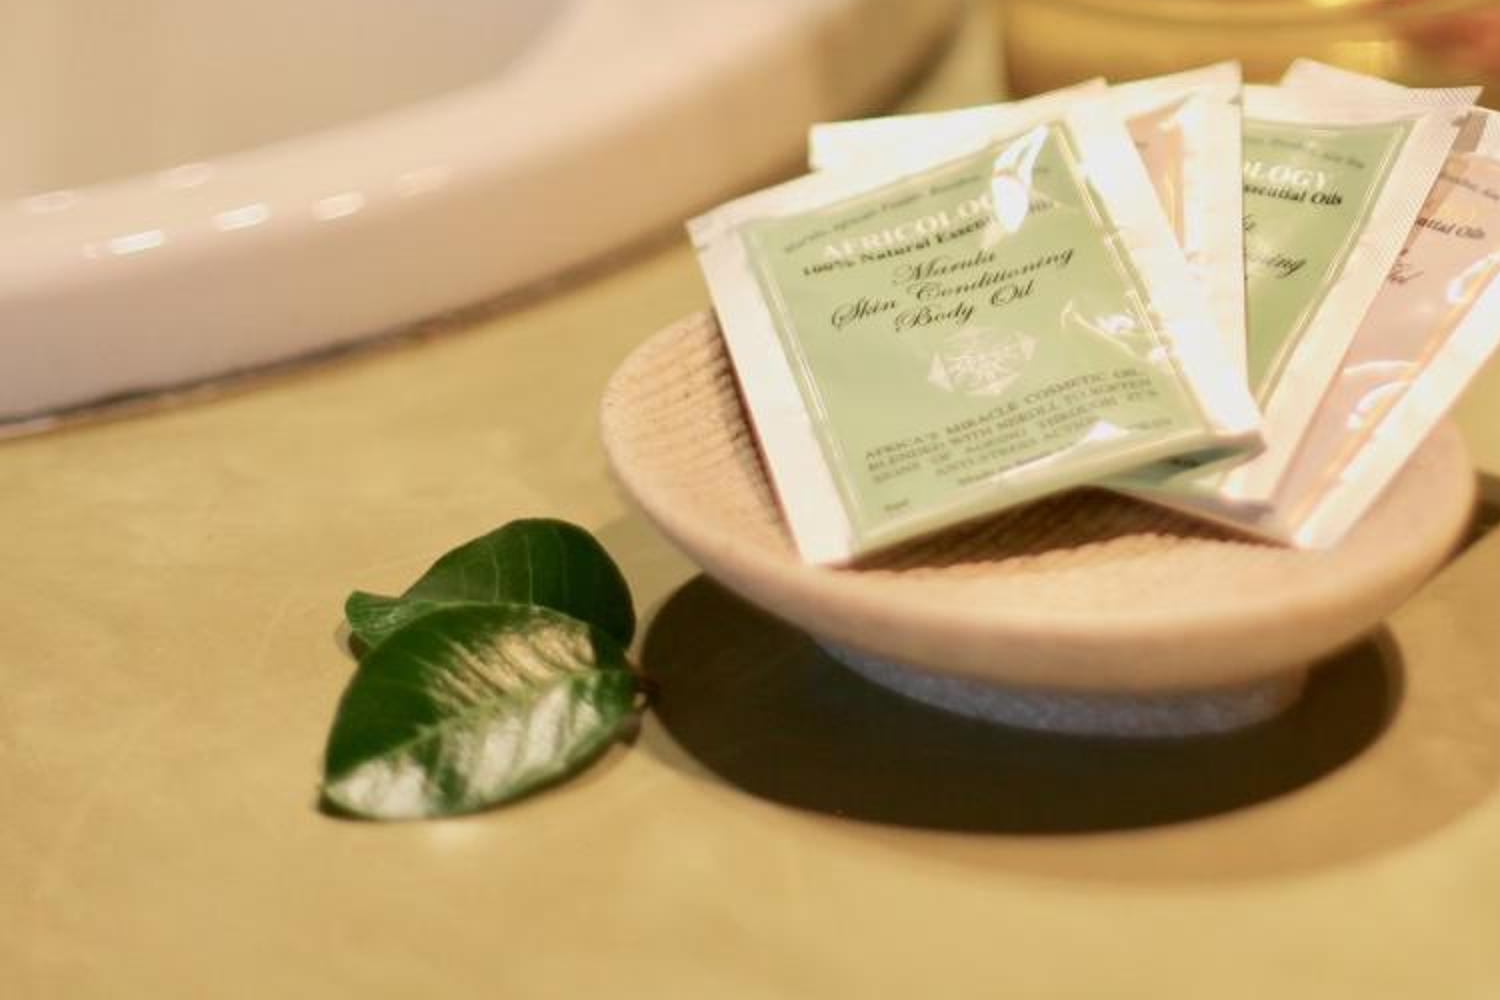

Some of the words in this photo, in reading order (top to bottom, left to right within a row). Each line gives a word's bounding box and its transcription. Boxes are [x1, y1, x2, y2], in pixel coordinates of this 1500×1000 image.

[1310, 188, 1344, 207] Oils
[861, 239, 931, 263] Natural
[831, 297, 896, 330] Skin
[906, 248, 1076, 302] Conditioning
[894, 301, 976, 332] Body
[990, 279, 1035, 308] Oil
